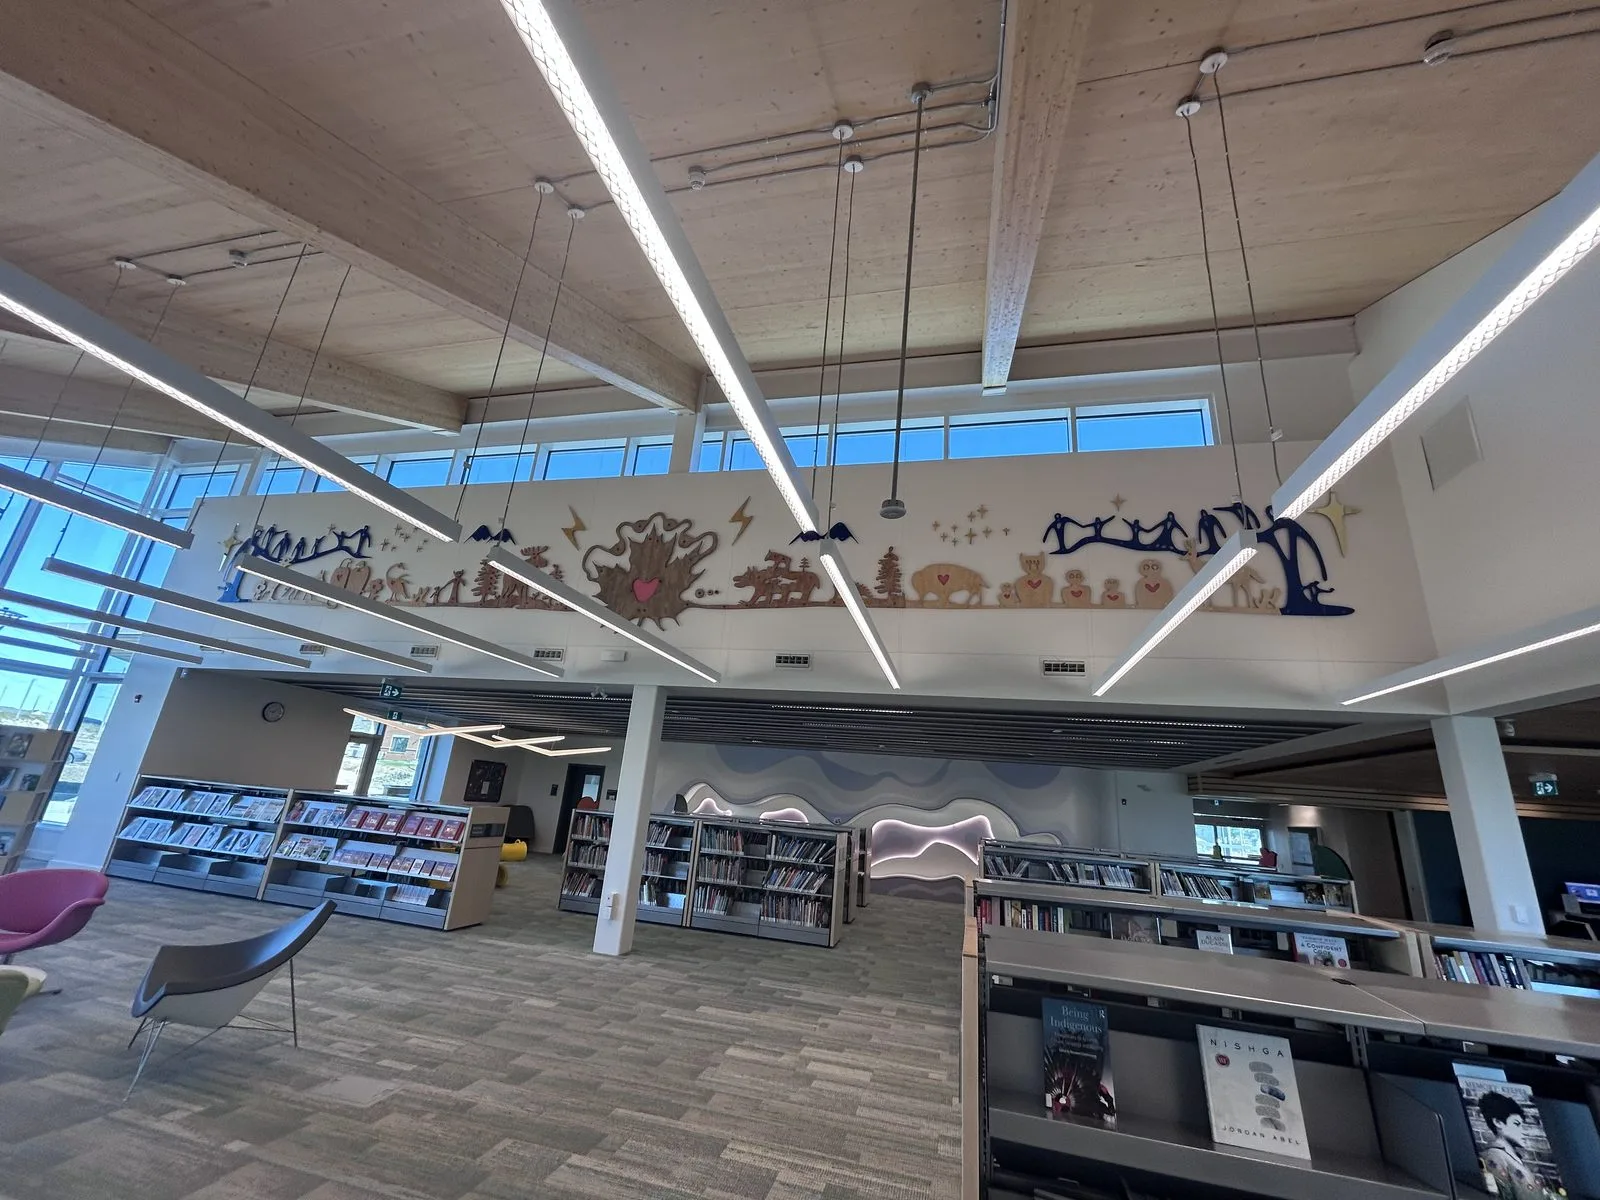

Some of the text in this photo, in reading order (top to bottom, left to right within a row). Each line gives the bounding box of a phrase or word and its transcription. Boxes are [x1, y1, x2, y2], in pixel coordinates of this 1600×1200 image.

[1306, 942, 1342, 952] CONFIDENT
[1061, 1006, 1089, 1022] Being
[1050, 1016, 1102, 1034] Indigenous
[1210, 1038, 1285, 1058] NISHGA
[1221, 1125, 1301, 1146] JORDAN ABEL
